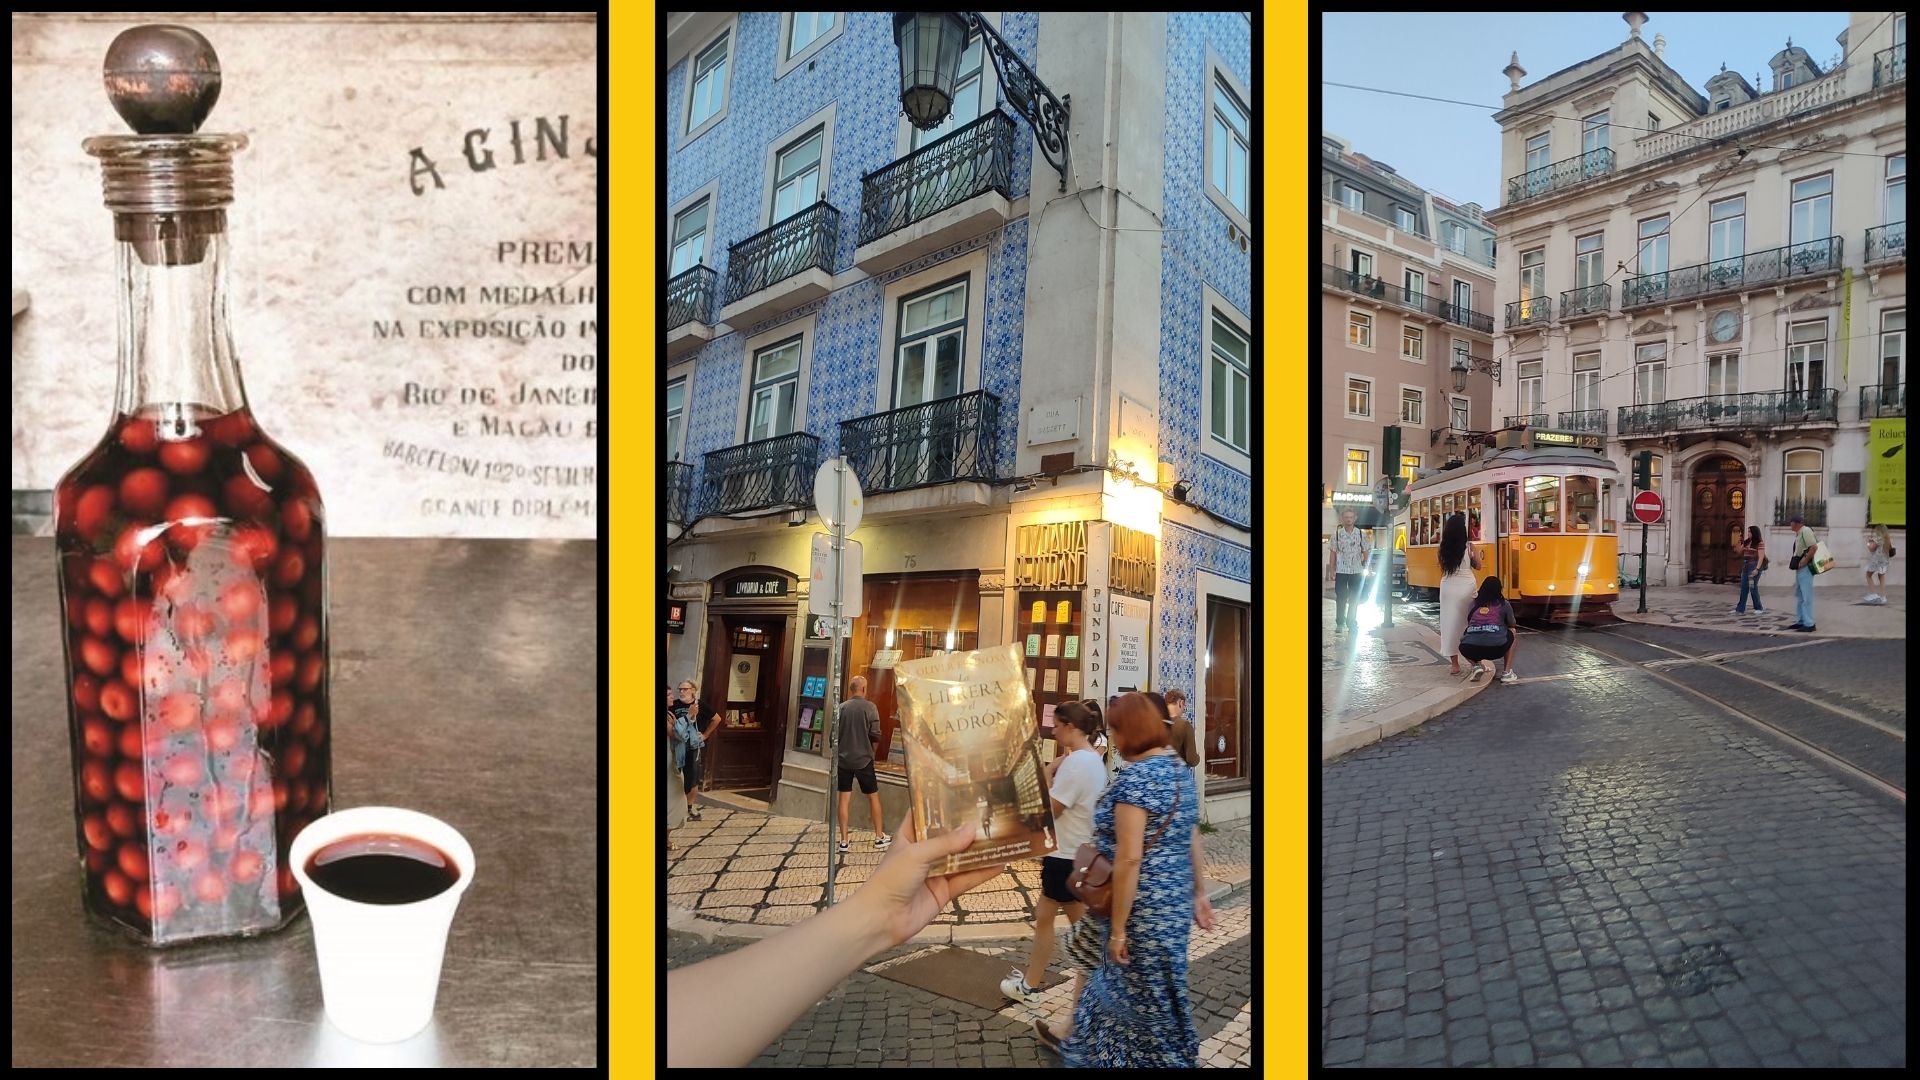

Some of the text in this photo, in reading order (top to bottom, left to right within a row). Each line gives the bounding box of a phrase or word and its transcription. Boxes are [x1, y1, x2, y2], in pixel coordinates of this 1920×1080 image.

[409, 114, 597, 196] A GIN
[497, 240, 594, 265] PREM
[406, 285, 596, 306] COM MEDALH
[372, 319, 405, 339] NA
[419, 314, 566, 341] EXPOSIÇÃO
[562, 353, 596, 372] DO
[1535, 432, 1599, 447] PRAZERES 28
[1333, 491, 1373, 502] McDonal
[512, 498, 597, 520] DIPLOM
[904, 554, 917, 569] 75
[1090, 588, 1102, 688] FUNDADA
